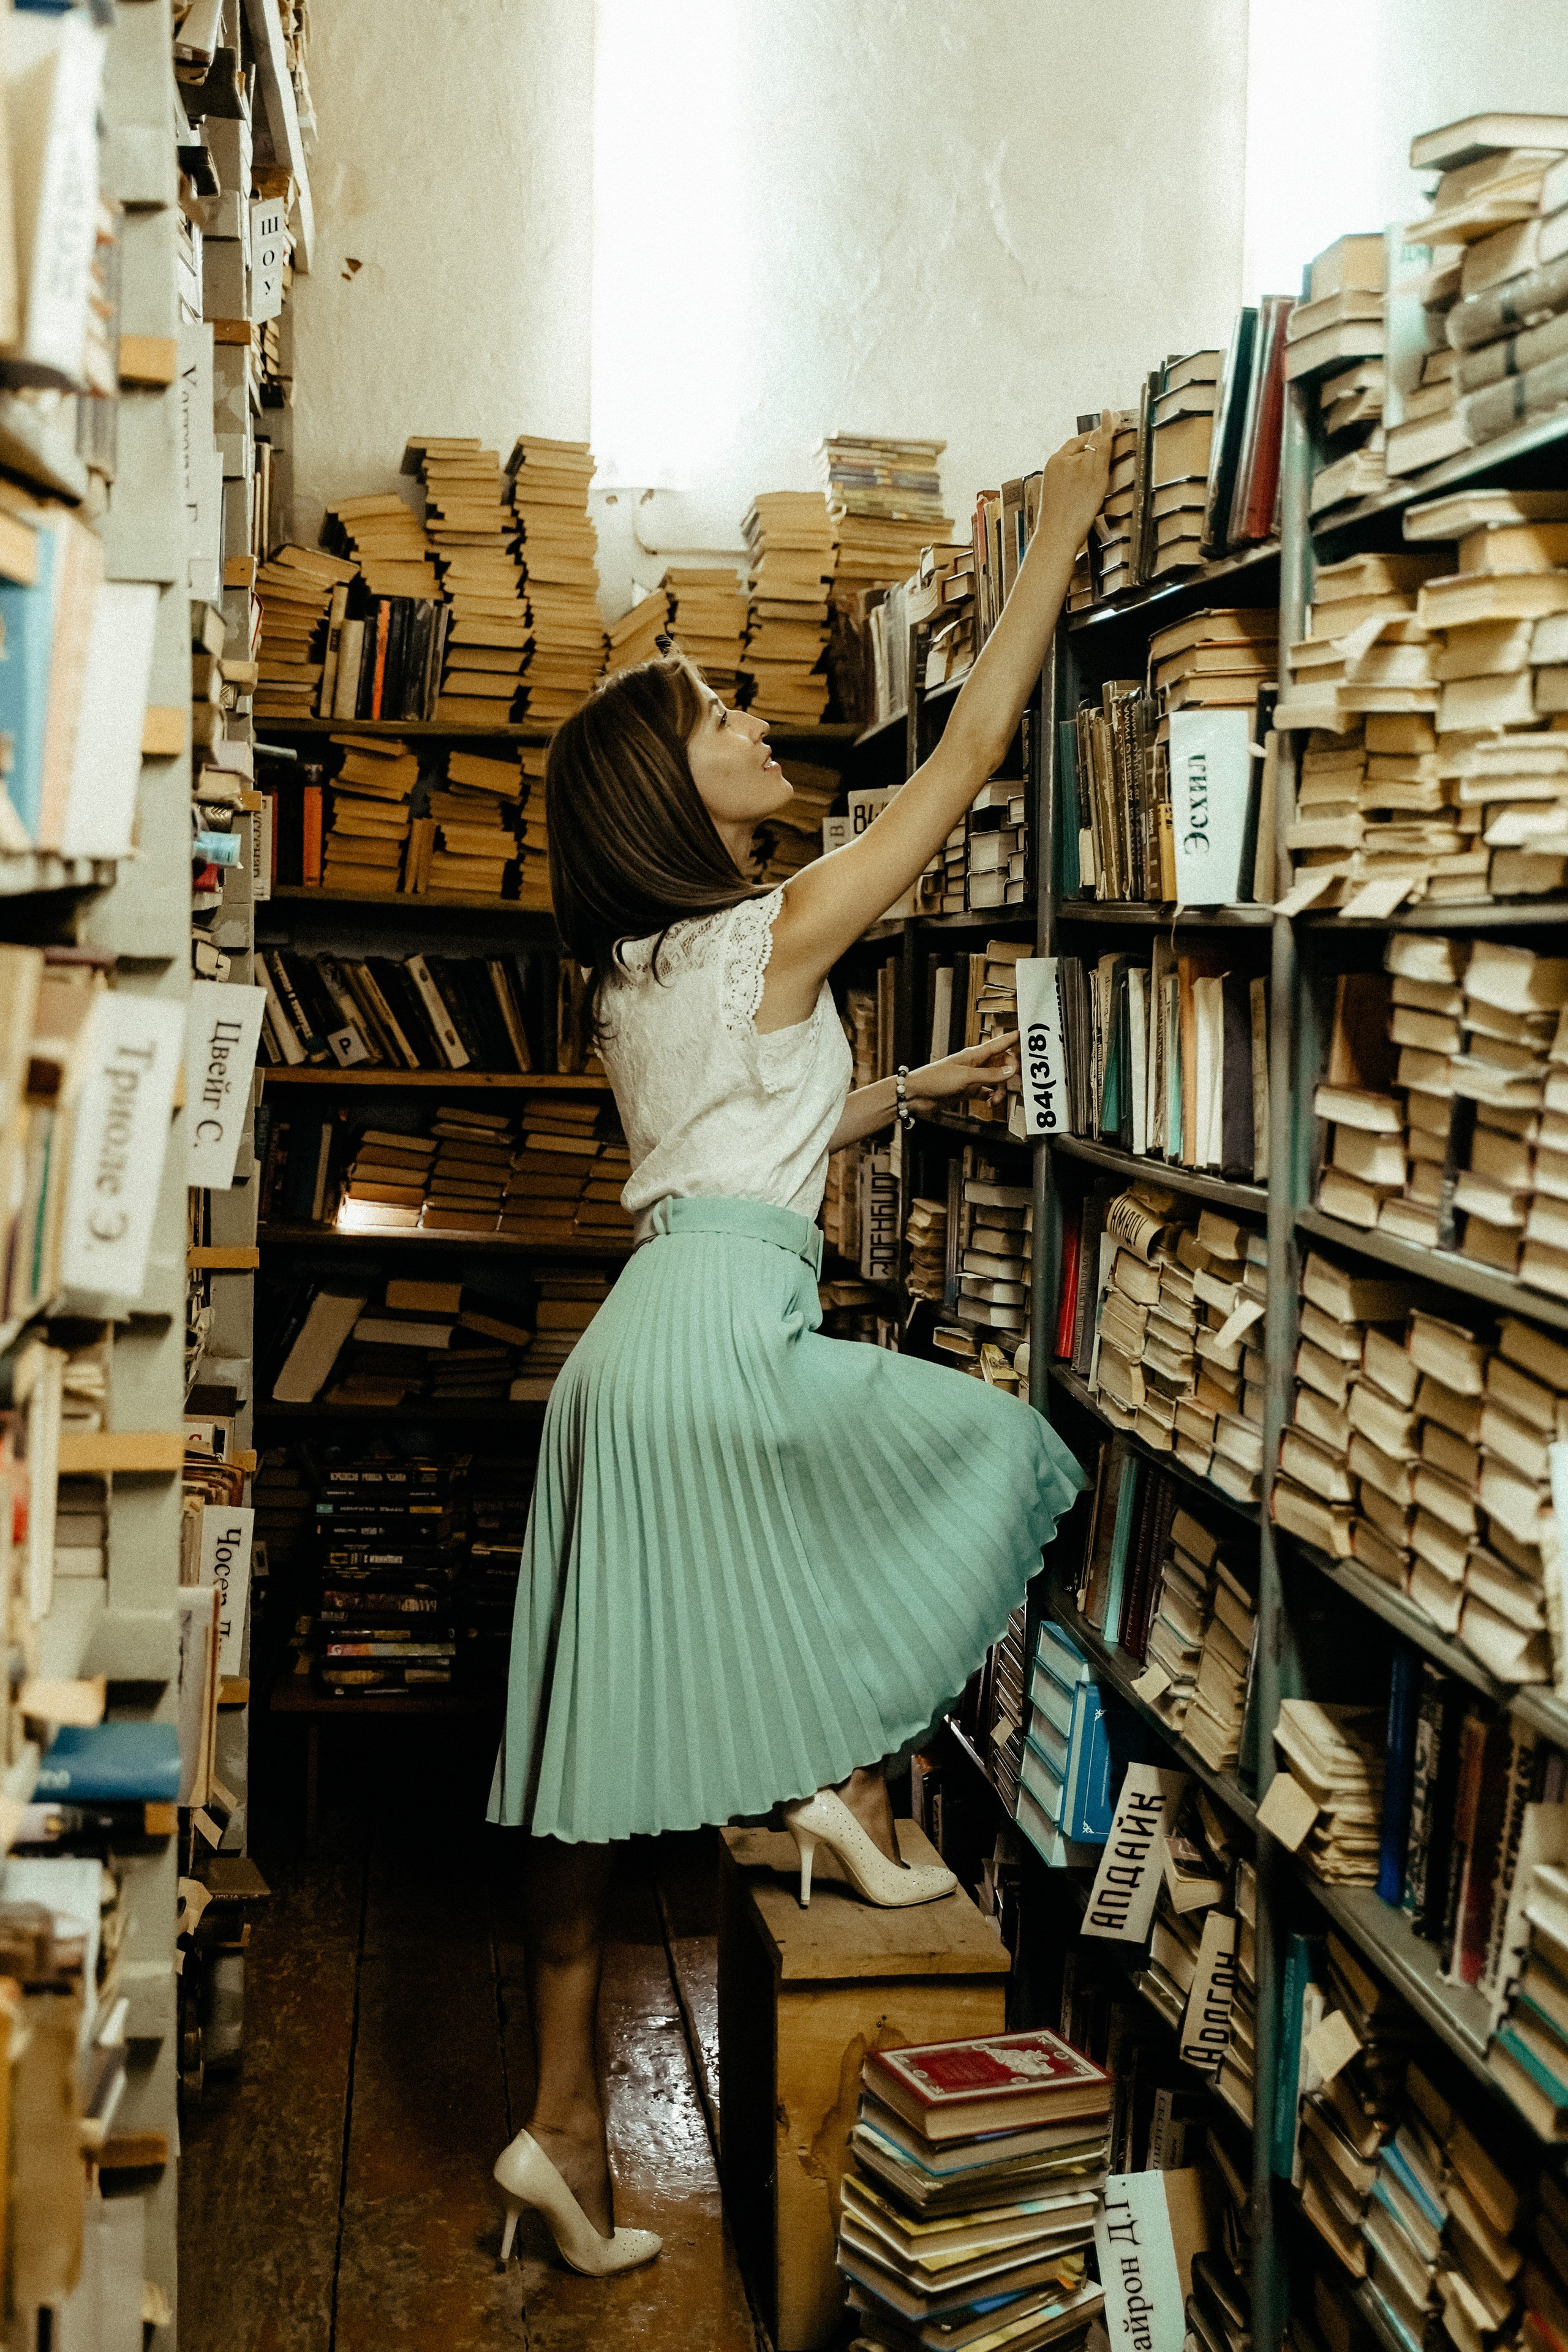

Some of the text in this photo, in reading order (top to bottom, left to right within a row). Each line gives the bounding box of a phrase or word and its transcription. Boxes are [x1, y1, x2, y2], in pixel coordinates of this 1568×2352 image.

[1123, 704, 1131, 741] РИМА
[202, 1019, 243, 1110] Цвейг
[1028, 1022, 1057, 1129] 84(3/8)
[96, 1040, 157, 1196] Триоле
